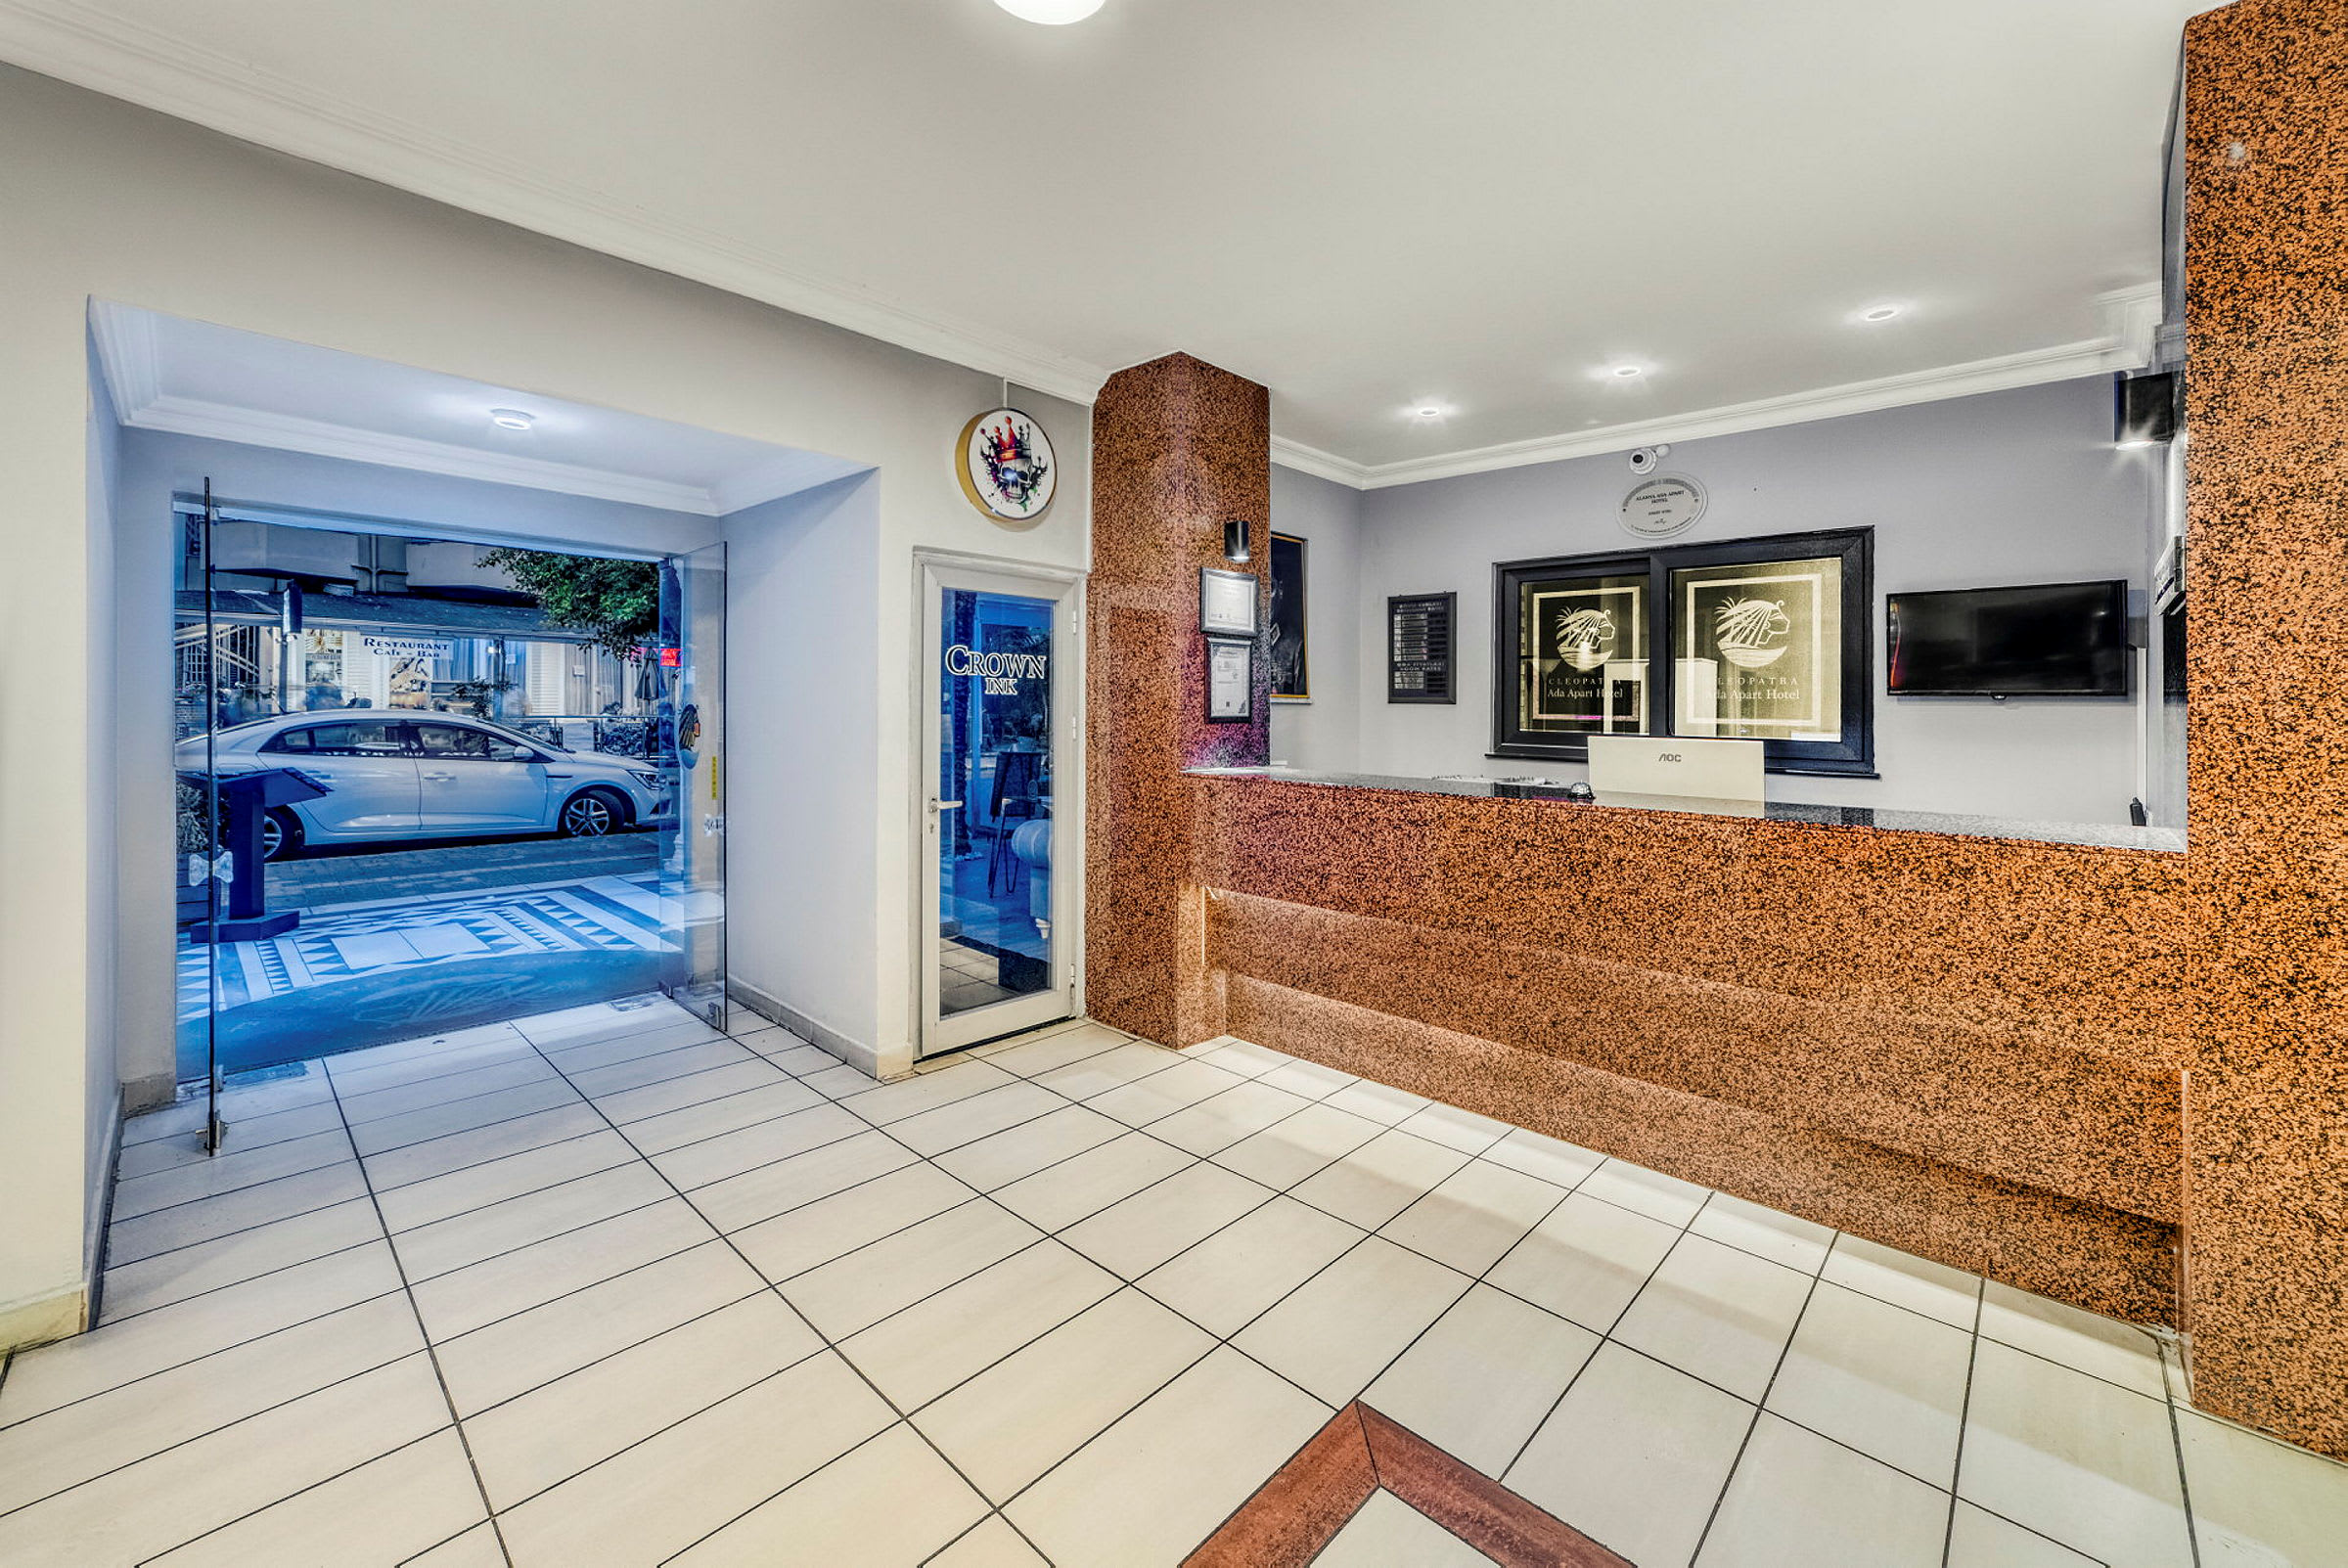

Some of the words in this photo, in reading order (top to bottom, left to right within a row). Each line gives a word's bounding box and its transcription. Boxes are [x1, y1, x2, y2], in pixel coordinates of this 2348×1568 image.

[364, 638, 450, 650] RESTAURANT
[945, 645, 1047, 679] CROWN
[984, 677, 1017, 694] INK
[1706, 677, 1797, 686] LEOPATRA
[1548, 688, 1564, 697] Ada
[1567, 689, 1593, 699] Apart
[1730, 689, 1762, 701] Apart
[1766, 689, 1800, 699] Hotel
[1658, 753, 1682, 762] AOC
